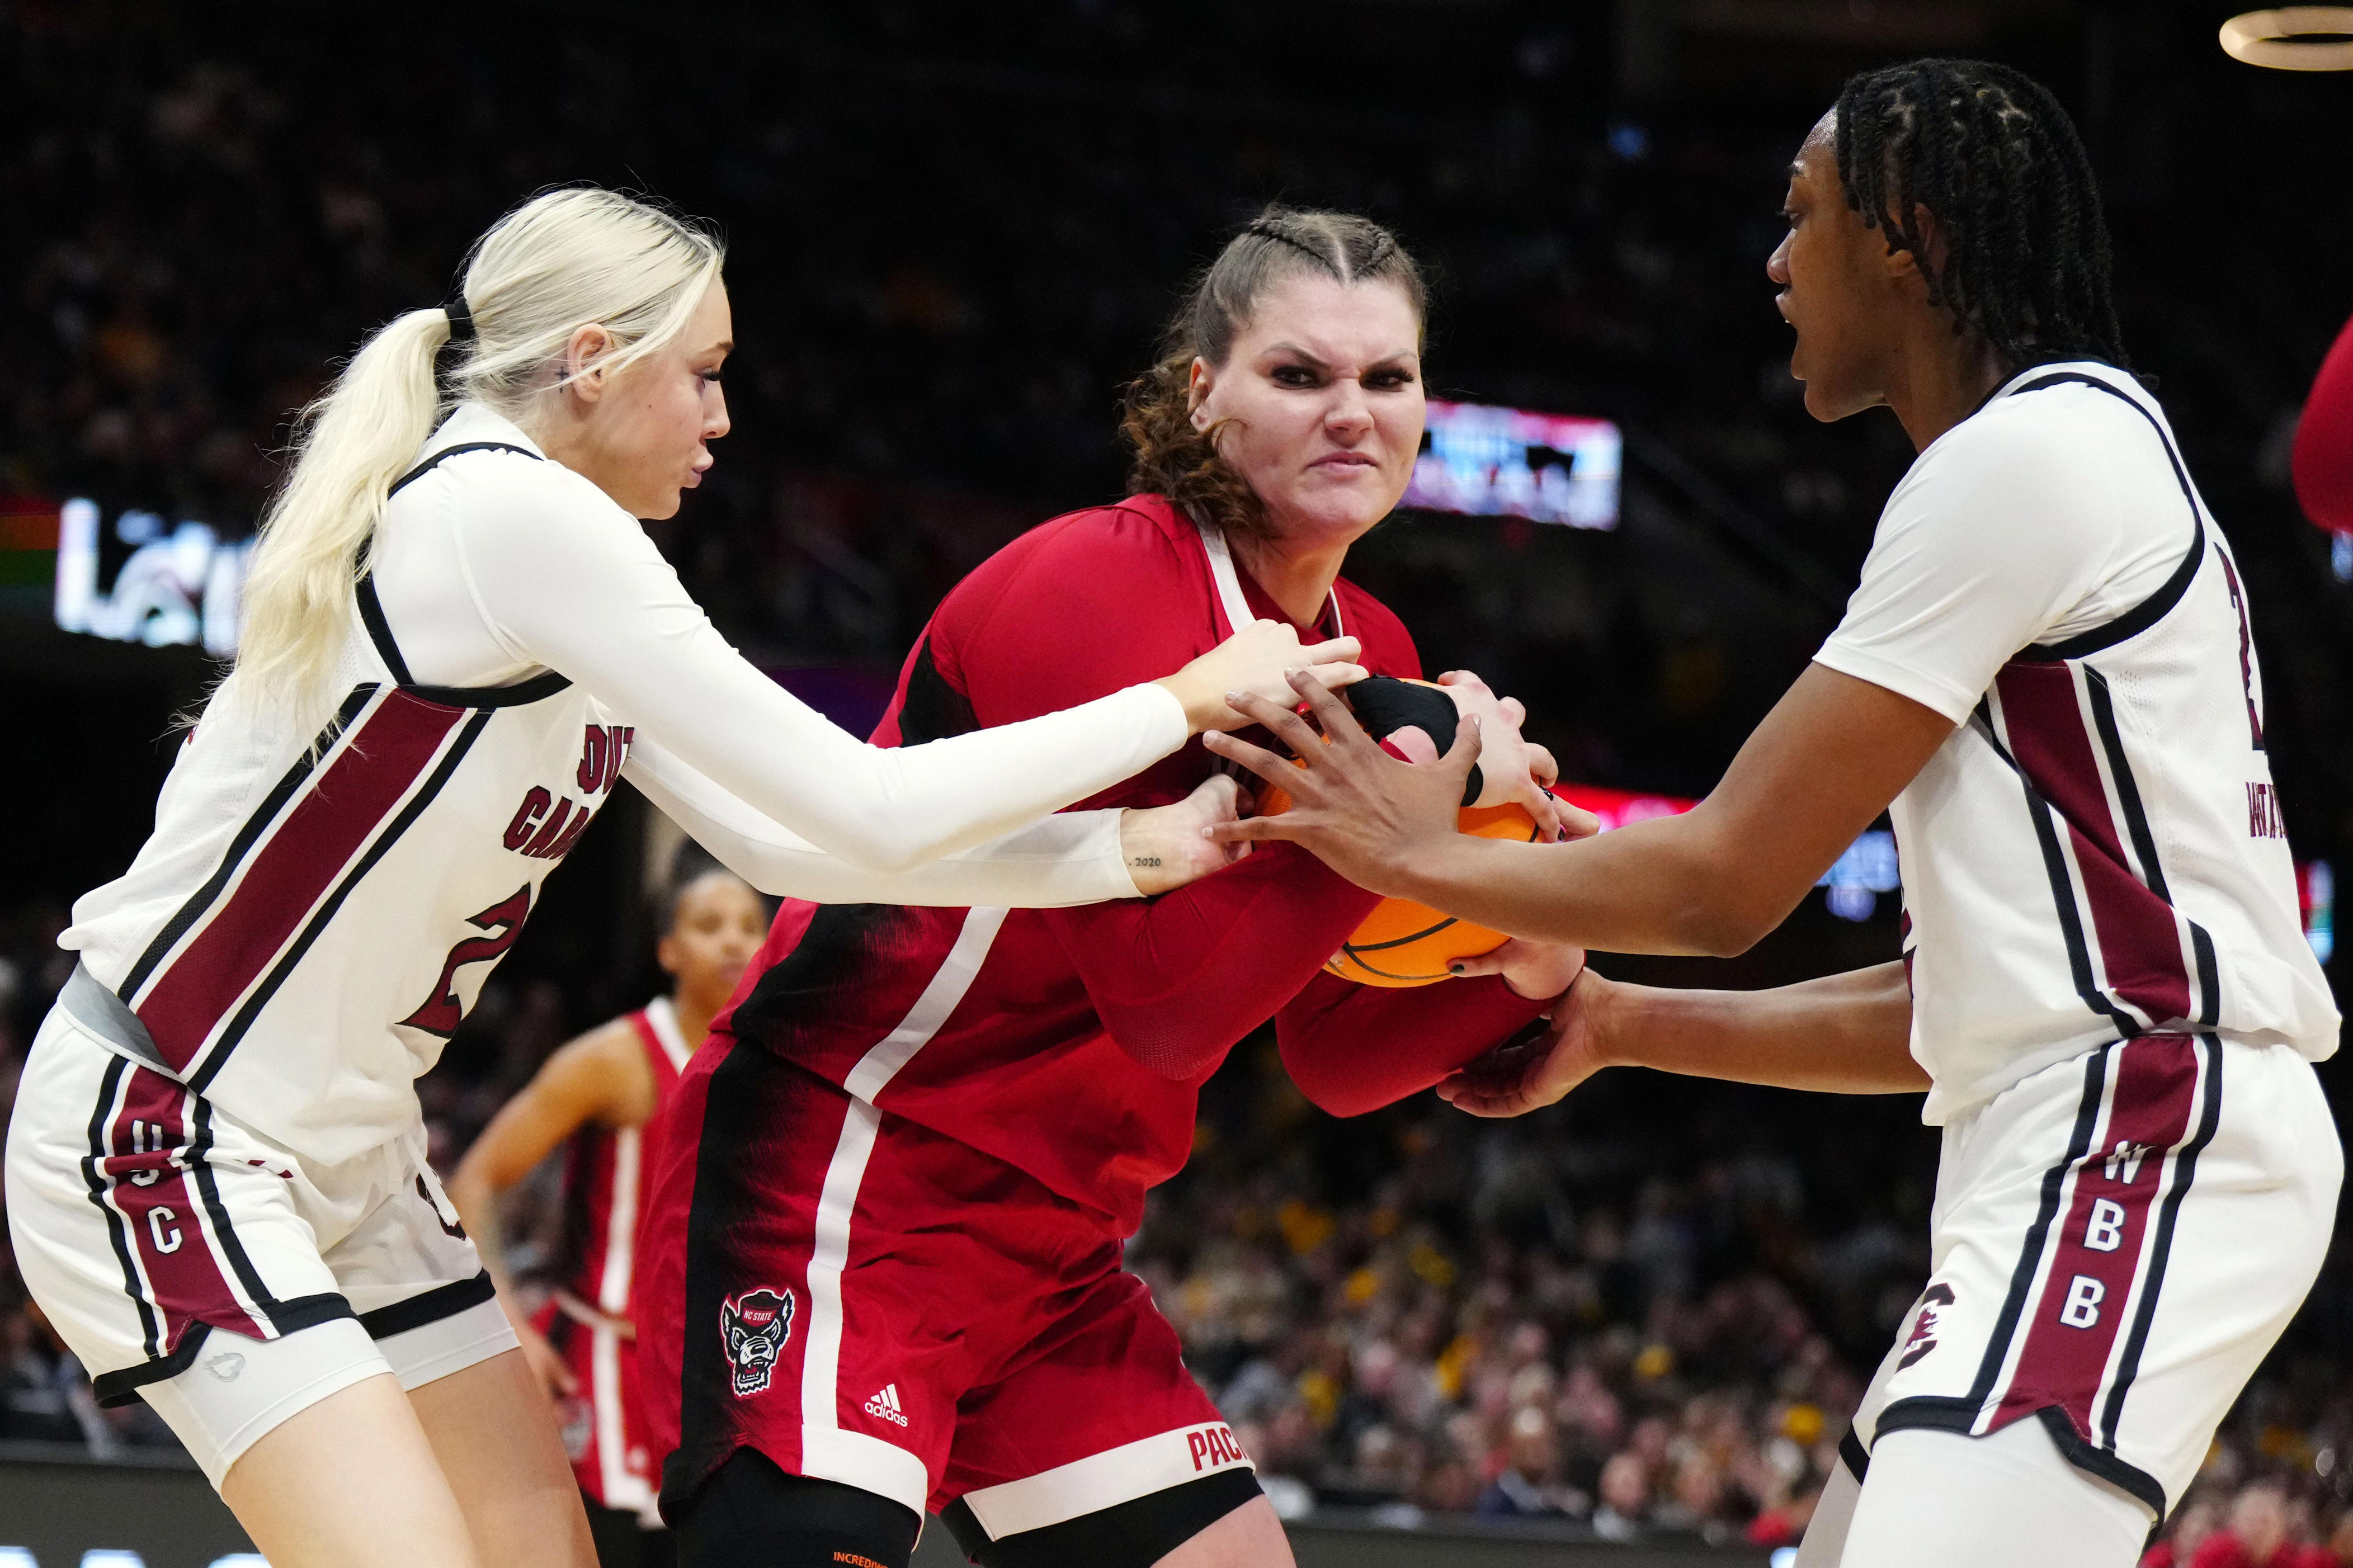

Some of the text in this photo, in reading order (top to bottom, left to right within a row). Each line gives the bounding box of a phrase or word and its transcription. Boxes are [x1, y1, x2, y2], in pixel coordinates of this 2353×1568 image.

[1135, 857, 1161, 867] 2020
[744, 1310, 772, 1321] NC STATE
[864, 1402, 908, 1427] adidas
[1186, 1427, 1247, 1472] PAC
